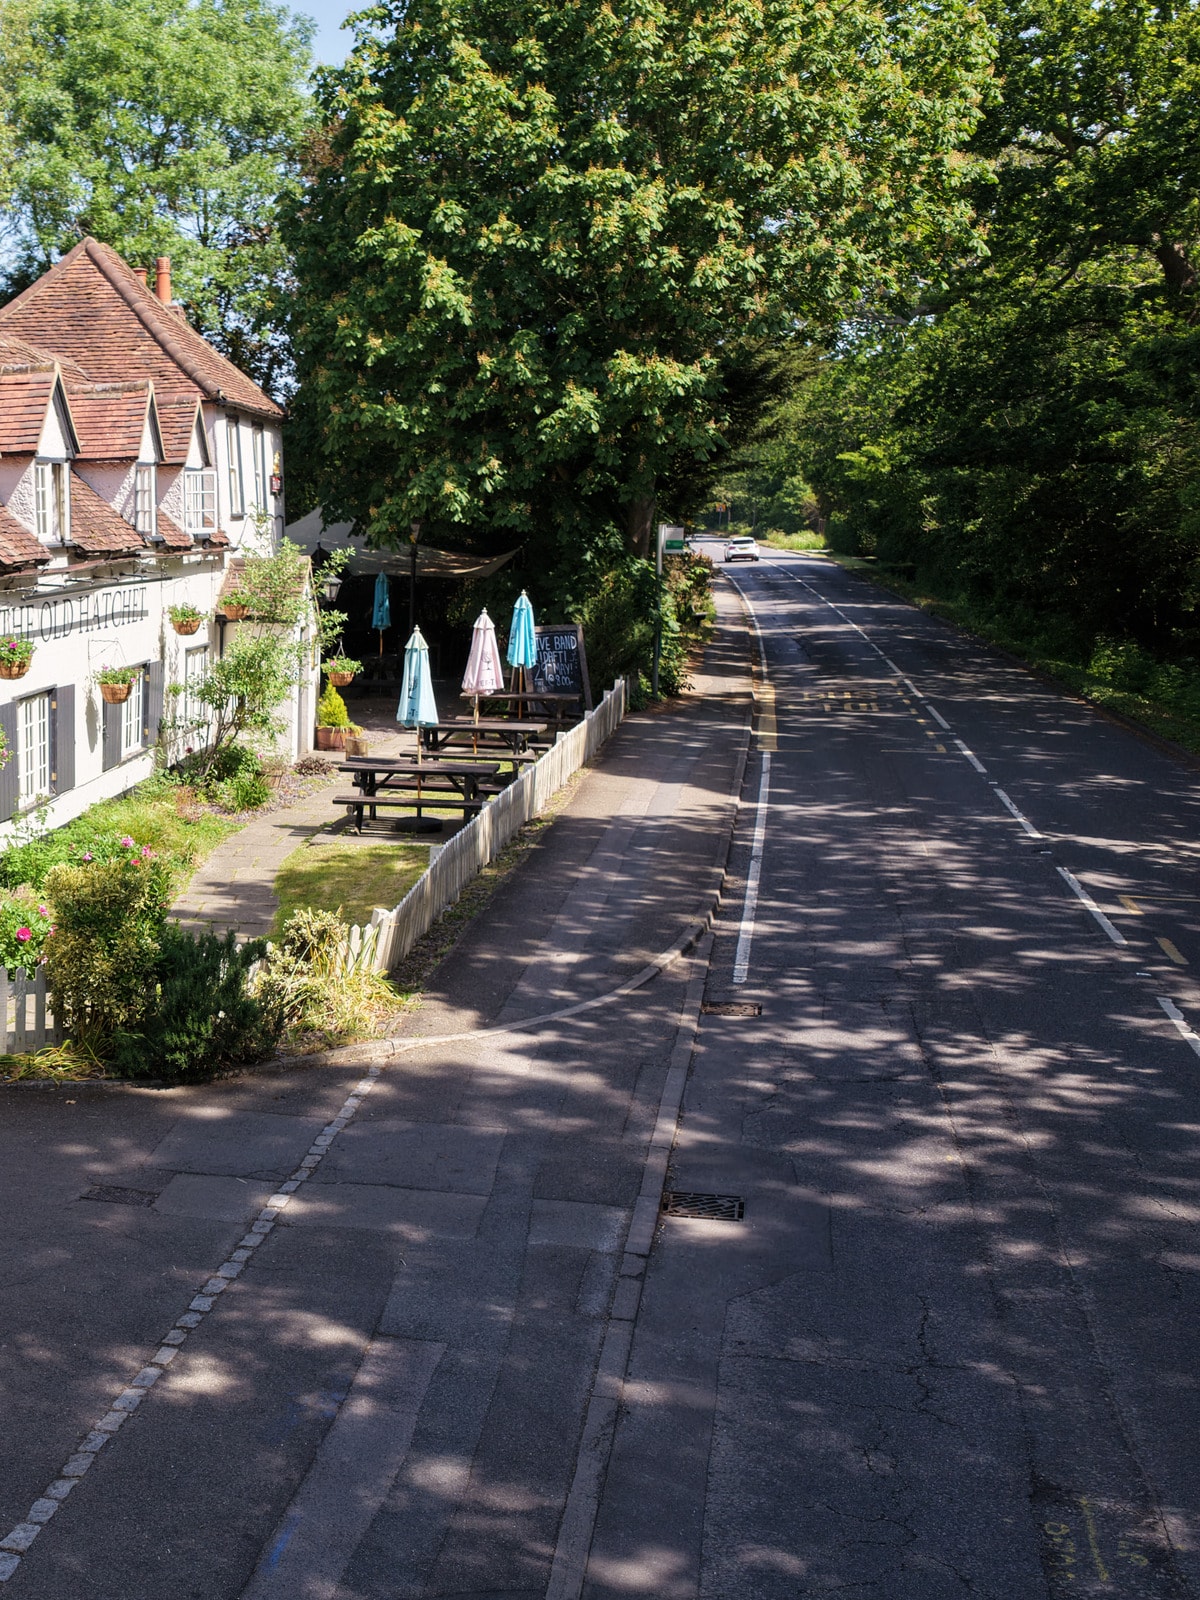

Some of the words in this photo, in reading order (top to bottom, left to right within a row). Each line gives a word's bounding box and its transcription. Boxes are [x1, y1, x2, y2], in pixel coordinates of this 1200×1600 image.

[0, 604, 34, 643] THE
[40, 598, 74, 643] OLD
[79, 586, 147, 634] HATCHET
[535, 637, 550, 651] IVE
[553, 635, 577, 651] BAND
